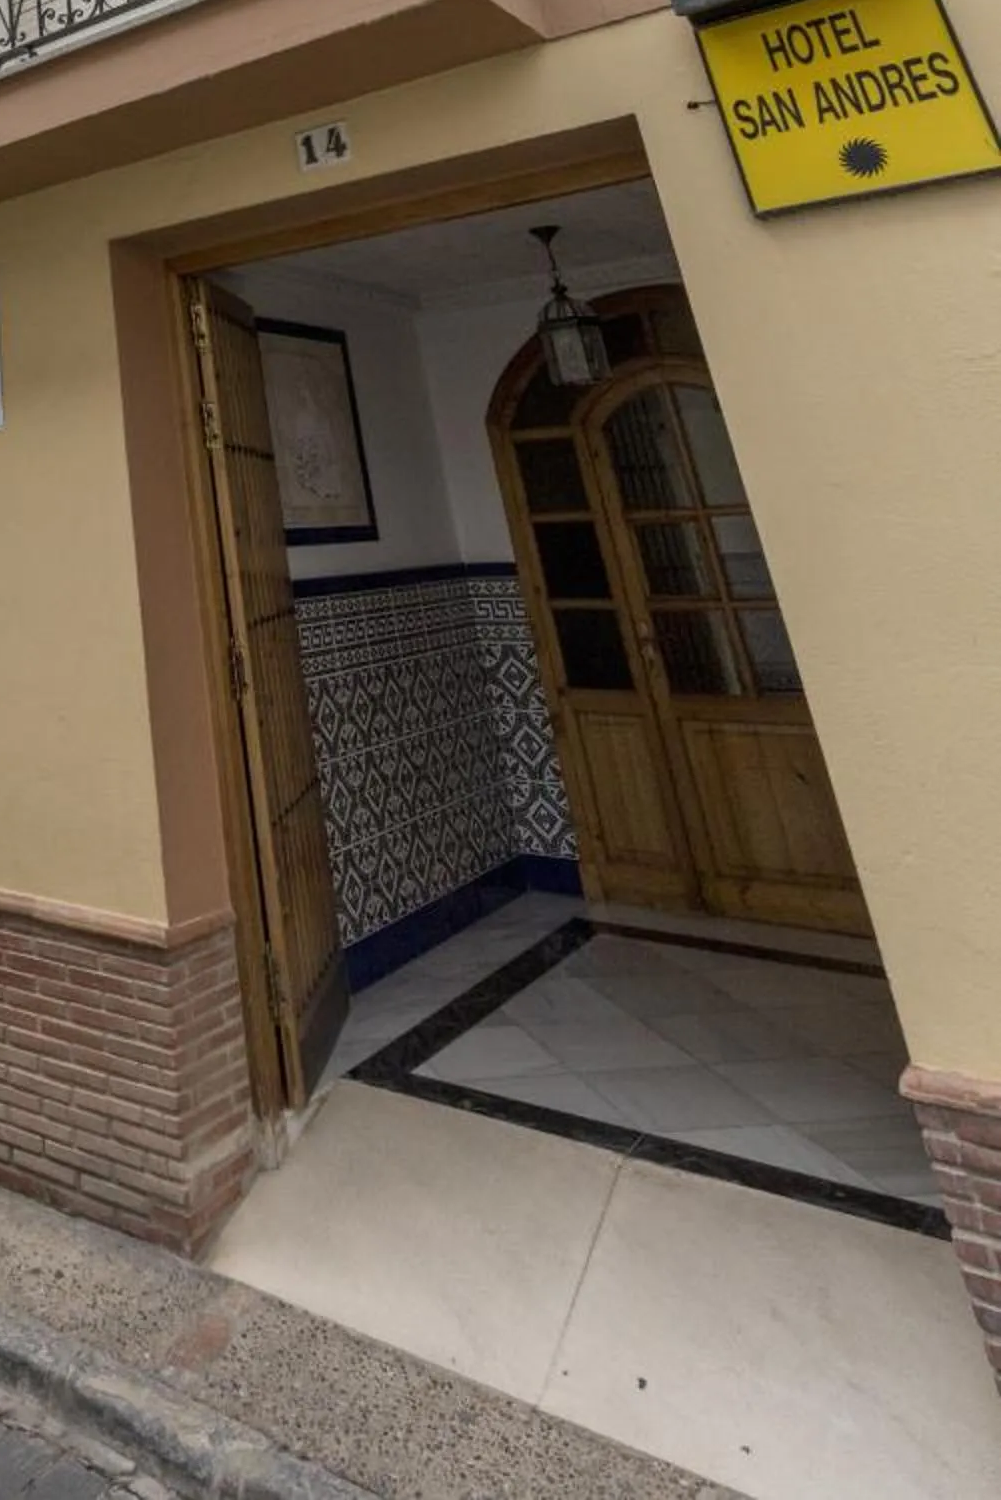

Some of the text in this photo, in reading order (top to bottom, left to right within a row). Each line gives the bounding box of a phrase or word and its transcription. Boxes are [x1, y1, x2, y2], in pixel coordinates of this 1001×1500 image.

[760, 8, 881, 73] HOTEL
[732, 52, 960, 140] SAN ANDRES
[301, 127, 348, 166] 14
